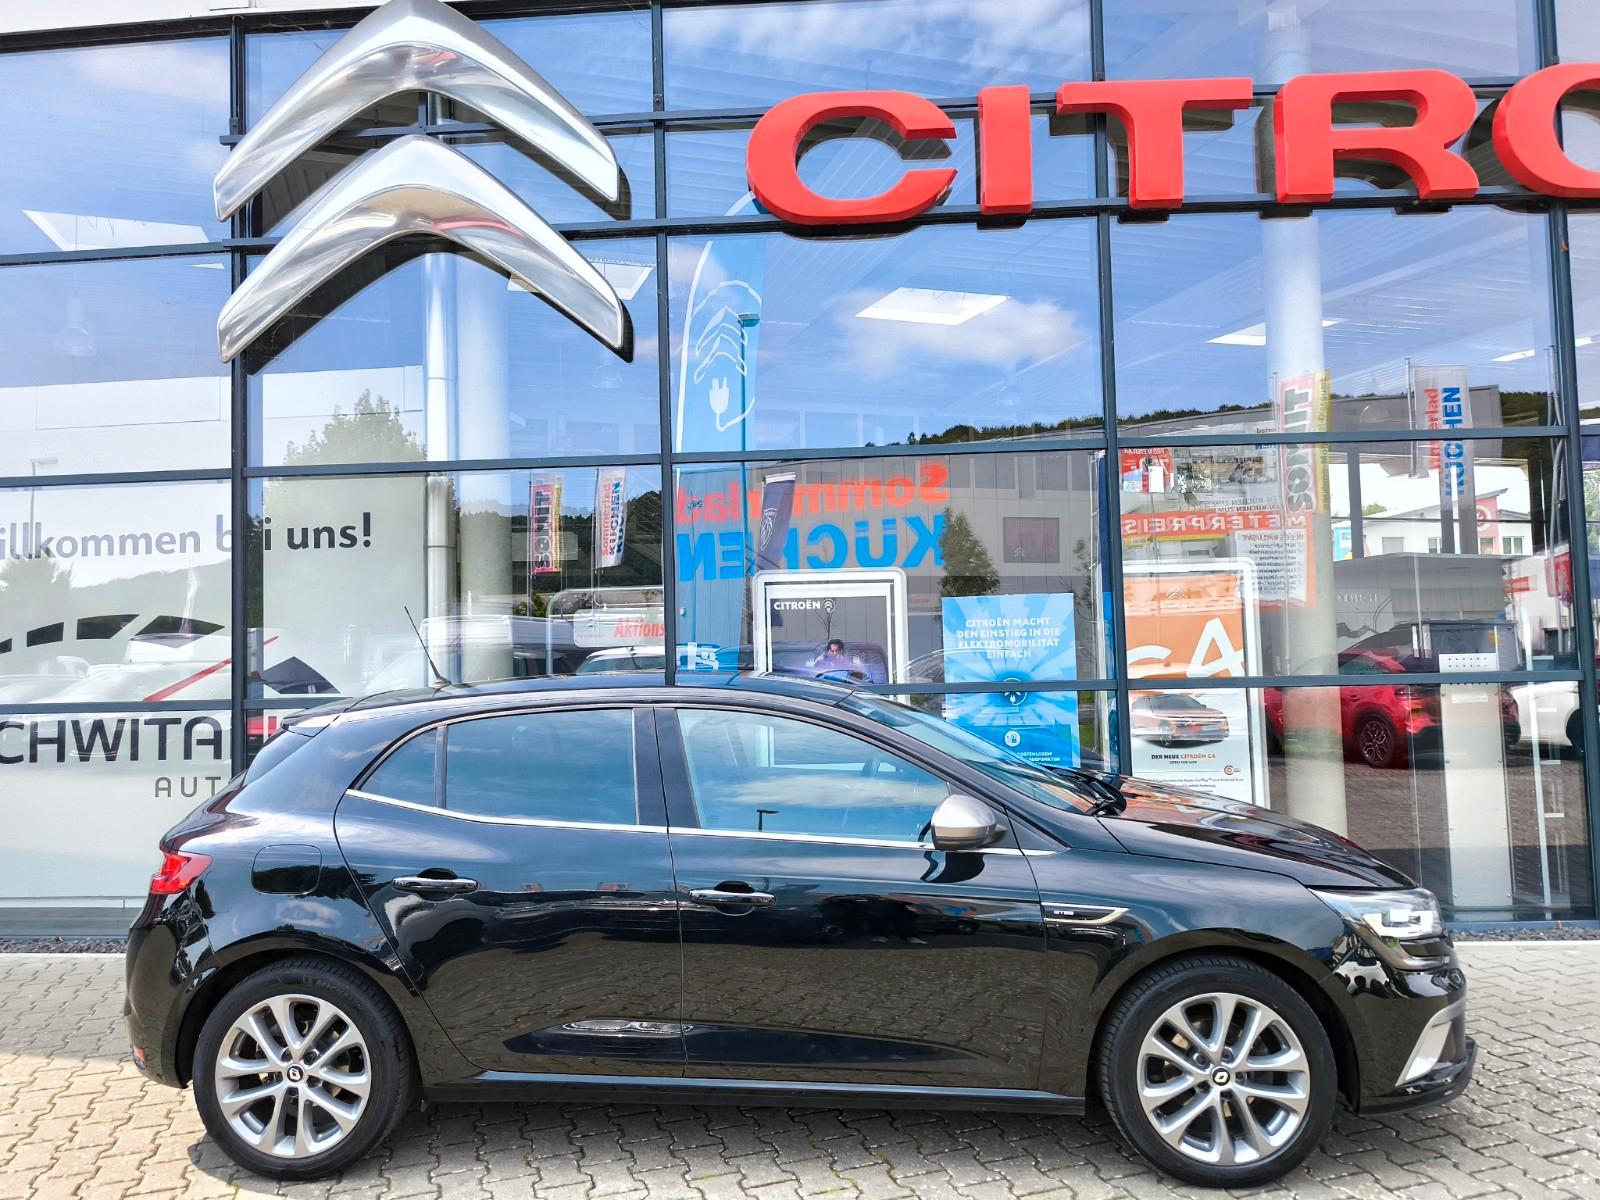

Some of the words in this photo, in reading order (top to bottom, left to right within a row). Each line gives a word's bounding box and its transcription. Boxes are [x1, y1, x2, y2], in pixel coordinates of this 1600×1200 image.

[215, 514, 272, 555] bi
[286, 511, 372, 550] uns!
[773, 599, 821, 611] CITROËN
[965, 616, 1010, 627] CITROËN
[1012, 616, 1051, 626] MACHT
[957, 630, 978, 638] DEN
[980, 628, 1027, 638] EINSTIEG
[1029, 628, 1041, 637] IN
[1043, 627, 1061, 636] DIE
[986, 649, 1032, 659] EINFACH
[0, 715, 277, 764] CHWITA
[155, 776, 222, 798] AUT
